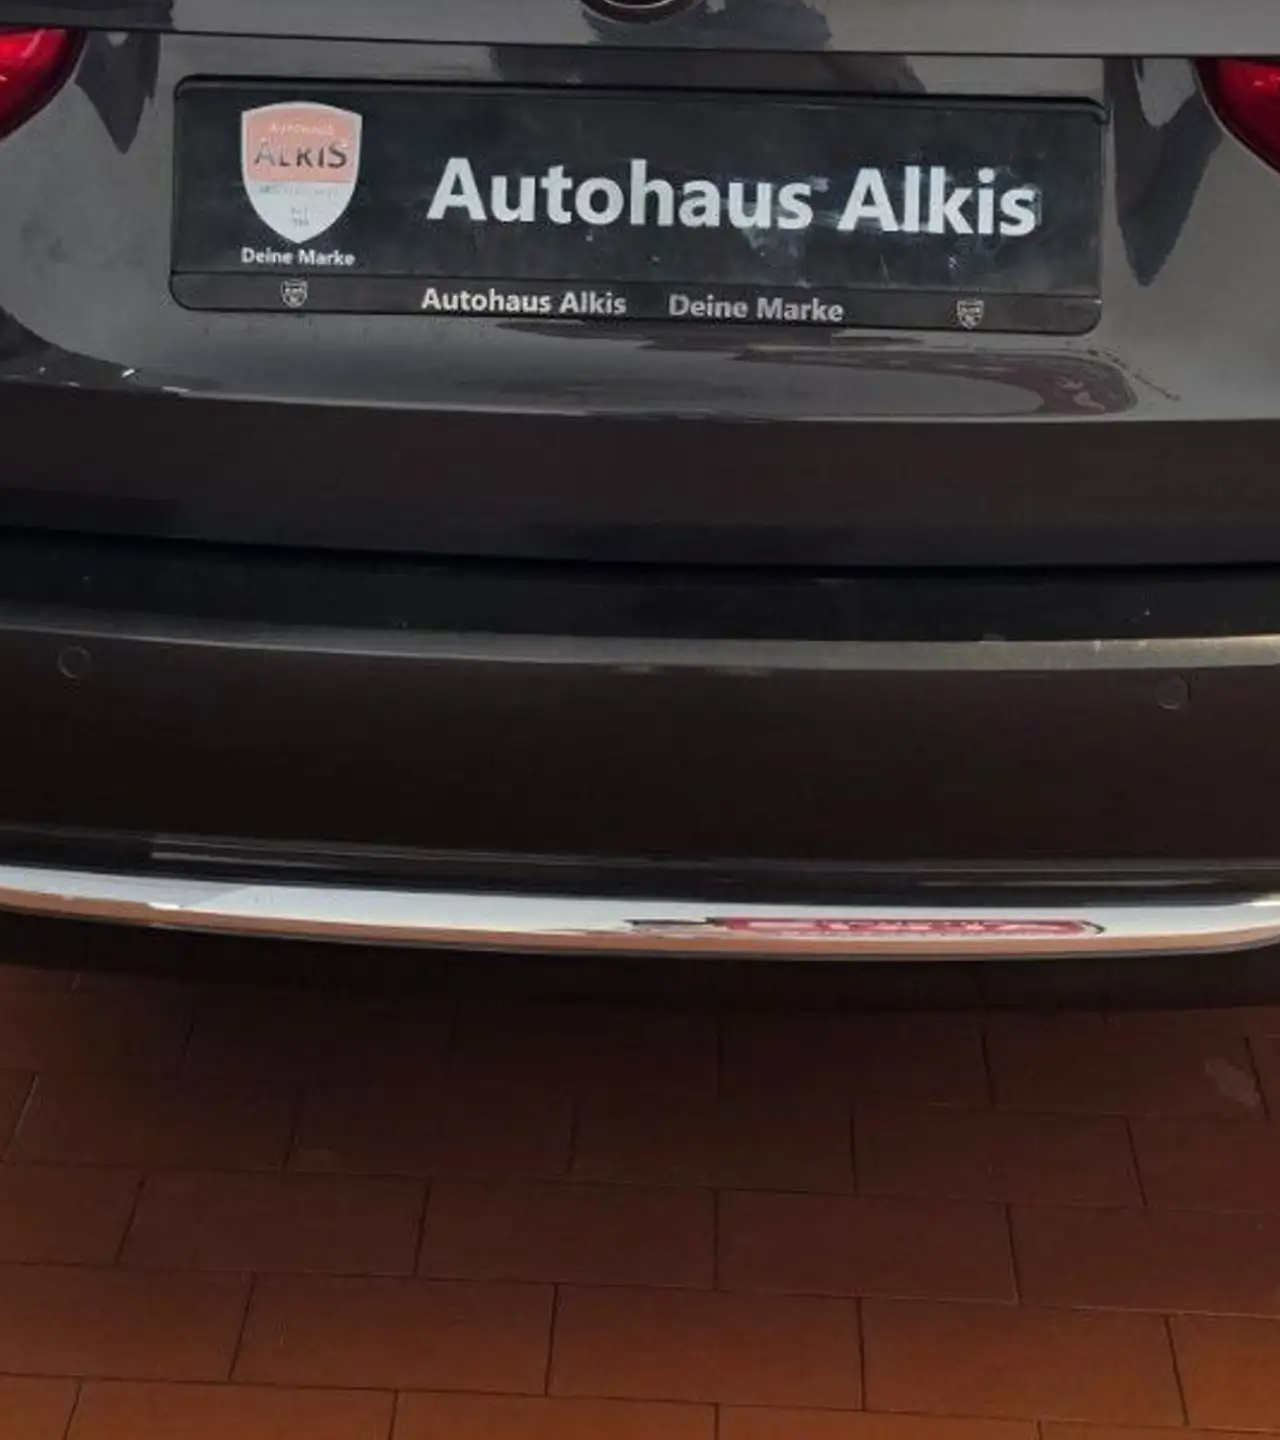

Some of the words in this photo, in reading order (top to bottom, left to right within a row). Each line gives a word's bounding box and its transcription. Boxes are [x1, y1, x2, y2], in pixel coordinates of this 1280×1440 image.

[254, 139, 347, 169] ALKIS
[426, 157, 813, 230] Autohaus
[836, 166, 1040, 237] Alkis
[240, 246, 294, 264] Deine
[297, 248, 356, 266] Marke
[421, 287, 553, 313] Autohaus
[558, 290, 628, 315] Alkis
[668, 293, 748, 320] Deine
[756, 296, 844, 322] Marke
